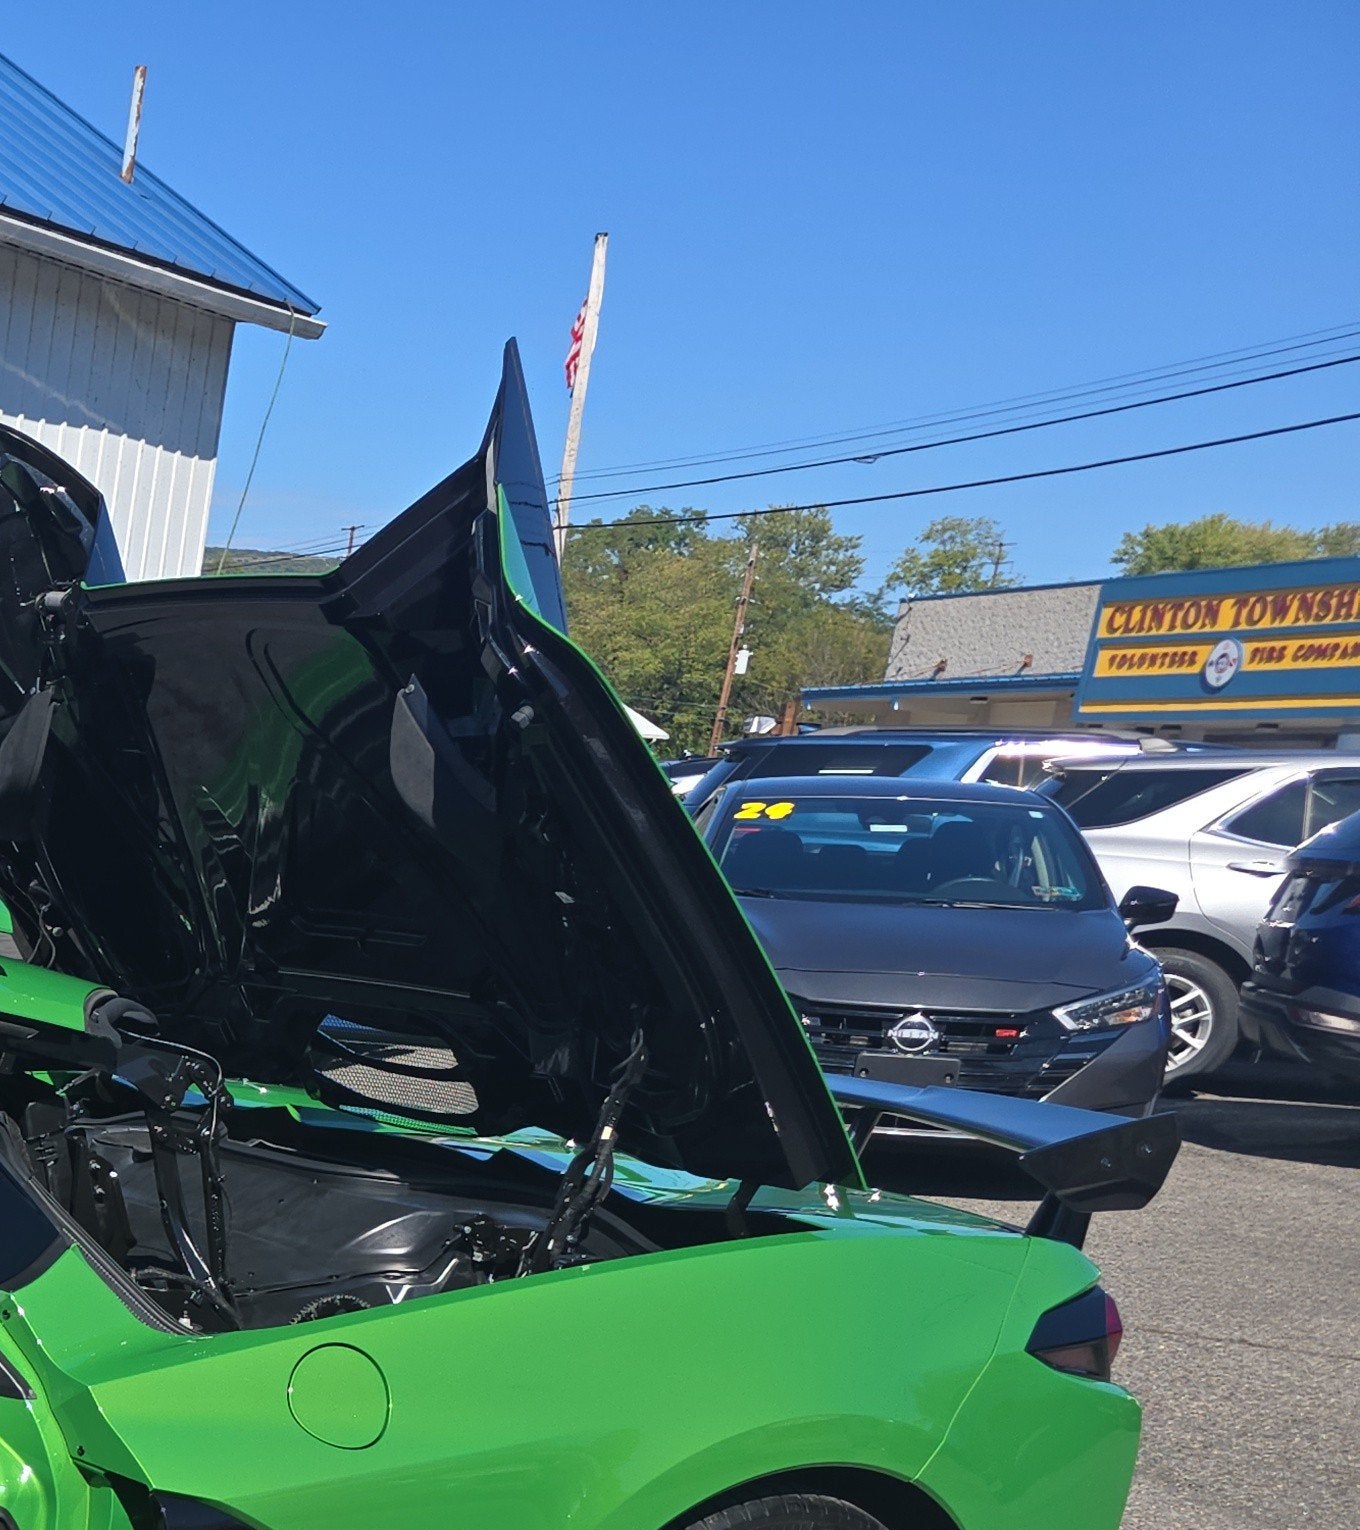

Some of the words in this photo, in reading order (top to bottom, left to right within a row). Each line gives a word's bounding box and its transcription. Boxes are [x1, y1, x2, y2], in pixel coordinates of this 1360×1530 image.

[1106, 600, 1221, 634] CLINTON
[1231, 589, 1360, 627] TOWNSH
[1108, 650, 1198, 670] VOLUNTEER
[1249, 645, 1288, 664] FIRE
[887, 1029, 939, 1040] NISSAN
